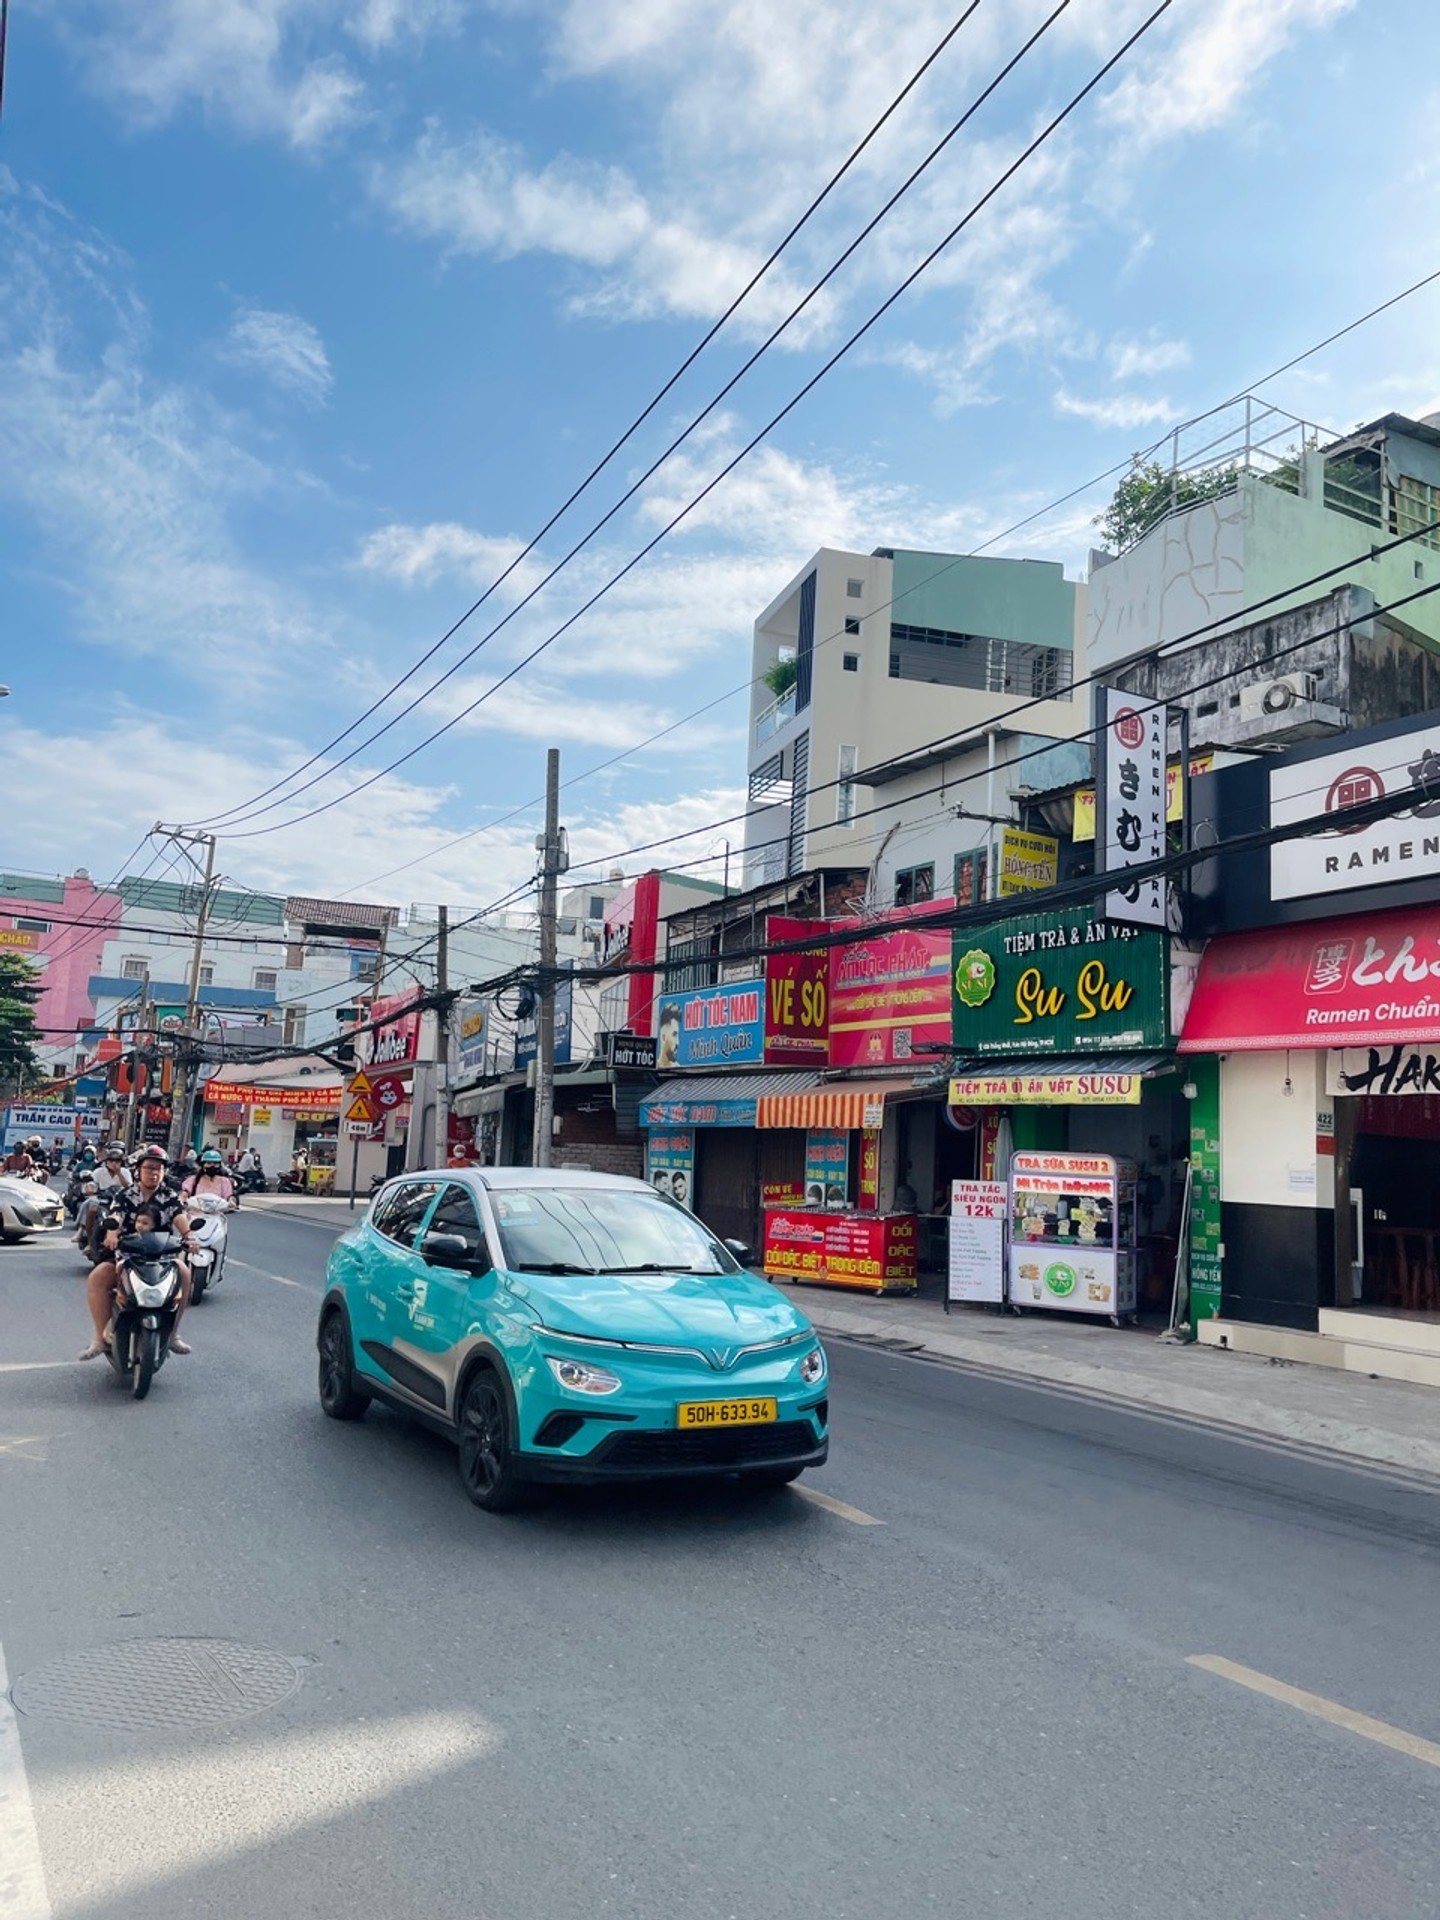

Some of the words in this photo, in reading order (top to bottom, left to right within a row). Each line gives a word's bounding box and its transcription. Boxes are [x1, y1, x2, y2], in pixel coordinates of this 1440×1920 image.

[1151, 713, 1160, 797] RAMEN
[1151, 812, 1160, 909] KIMRA
[1325, 836, 1440, 873] RAMEN
[1004, 931, 1036, 956] TIỆM
[1039, 925, 1067, 949] TRÀ
[1070, 927, 1080, 945] &
[1085, 918, 1105, 944] ĂN
[771, 966, 795, 1026] VÉ
[801, 964, 828, 1027] SỐ
[1013, 967, 1066, 1024] Su
[1075, 960, 1133, 1020] Su
[729, 991, 759, 1025] NAM
[1306, 1007, 1370, 1024] Ramen
[1375, 995, 1440, 1020] Chuẩn
[636, 1050, 654, 1066] TÓC
[1077, 1075, 1133, 1095] SUSU
[48, 1115, 72, 1125] CAO
[1317, 1113, 1333, 1124] 422
[1068, 1160, 1098, 1171] SUSU
[964, 1204, 994, 1217] 12k
[687, 1402, 769, 1424] 50H-633.94
